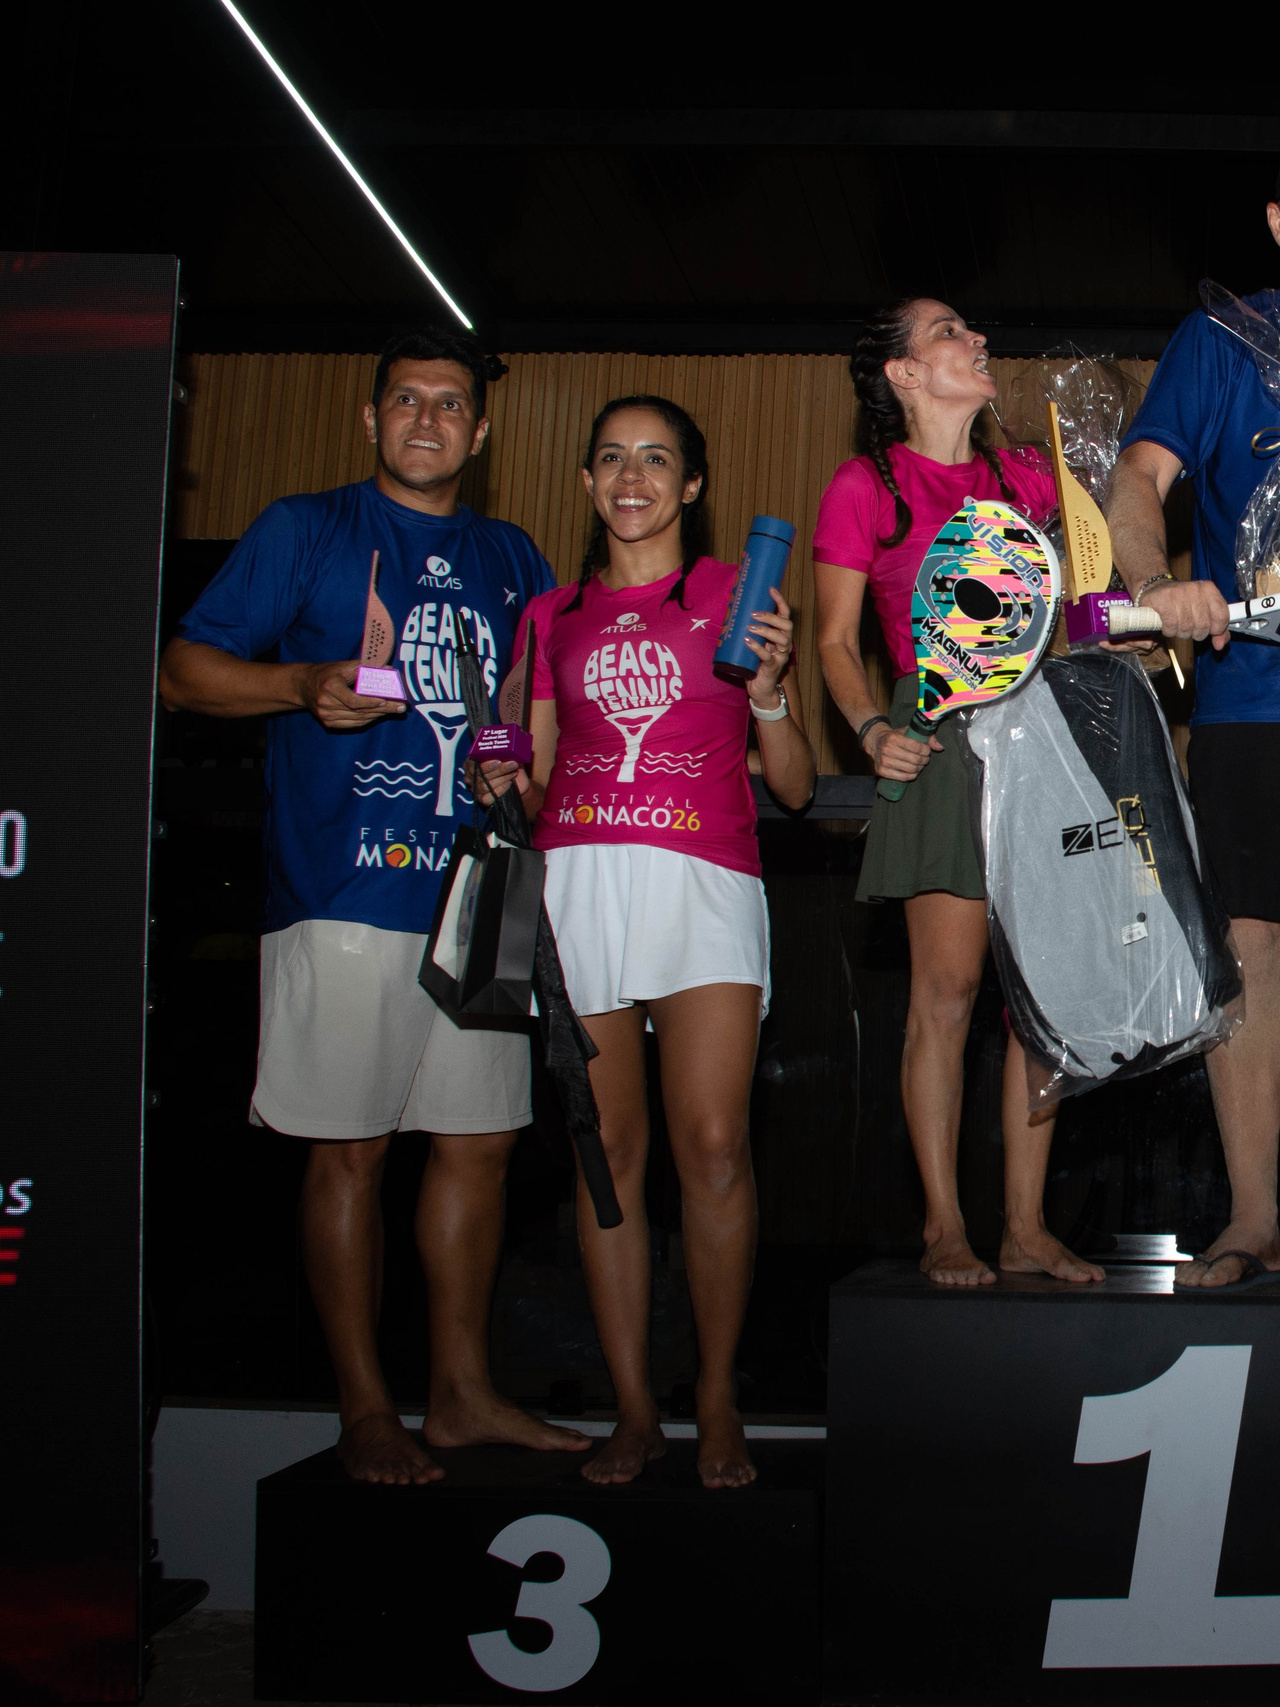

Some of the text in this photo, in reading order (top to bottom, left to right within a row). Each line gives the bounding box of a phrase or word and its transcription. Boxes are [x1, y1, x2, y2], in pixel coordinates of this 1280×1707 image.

[417, 574, 463, 590] ATLAS
[600, 623, 647, 634] ATLAS
[584, 640, 682, 684] BEACH
[920, 613, 991, 686] MAGNUM
[947, 661, 978, 692] EDITION
[584, 676, 683, 714] TENNIS
[563, 793, 693, 809] FESTIVAL
[558, 805, 701, 831] MONACO26
[360, 827, 456, 845] FESTI
[466, 1514, 612, 1693] 3
